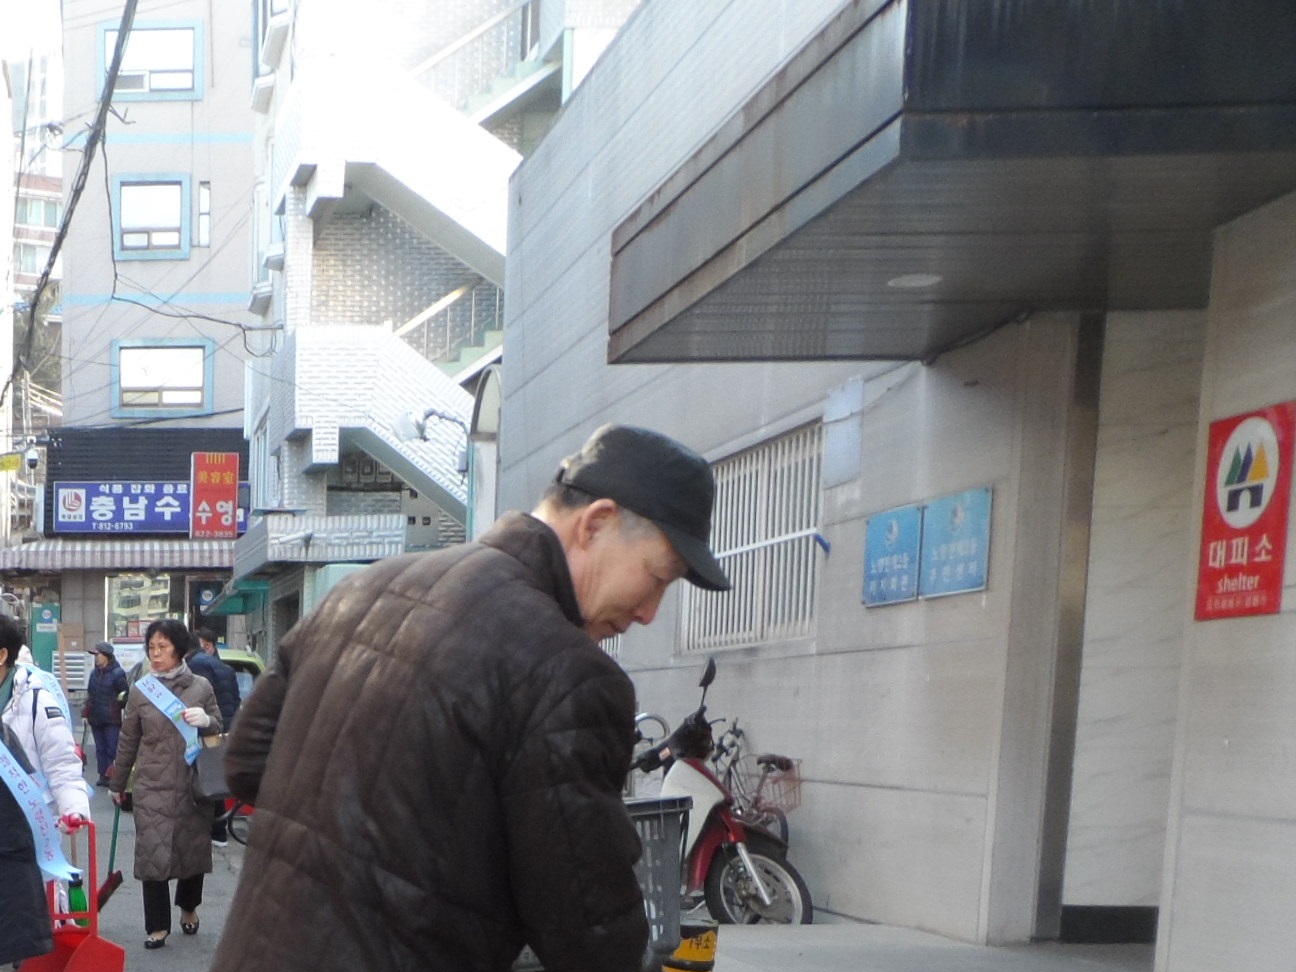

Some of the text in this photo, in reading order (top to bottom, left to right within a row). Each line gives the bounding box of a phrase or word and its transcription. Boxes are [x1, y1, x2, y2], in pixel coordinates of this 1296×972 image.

[90, 496, 190, 521] 충남수
[195, 500, 233, 526] 수영
[1208, 534, 1272, 569] 대피소
[1216, 572, 1260, 593] shelter
